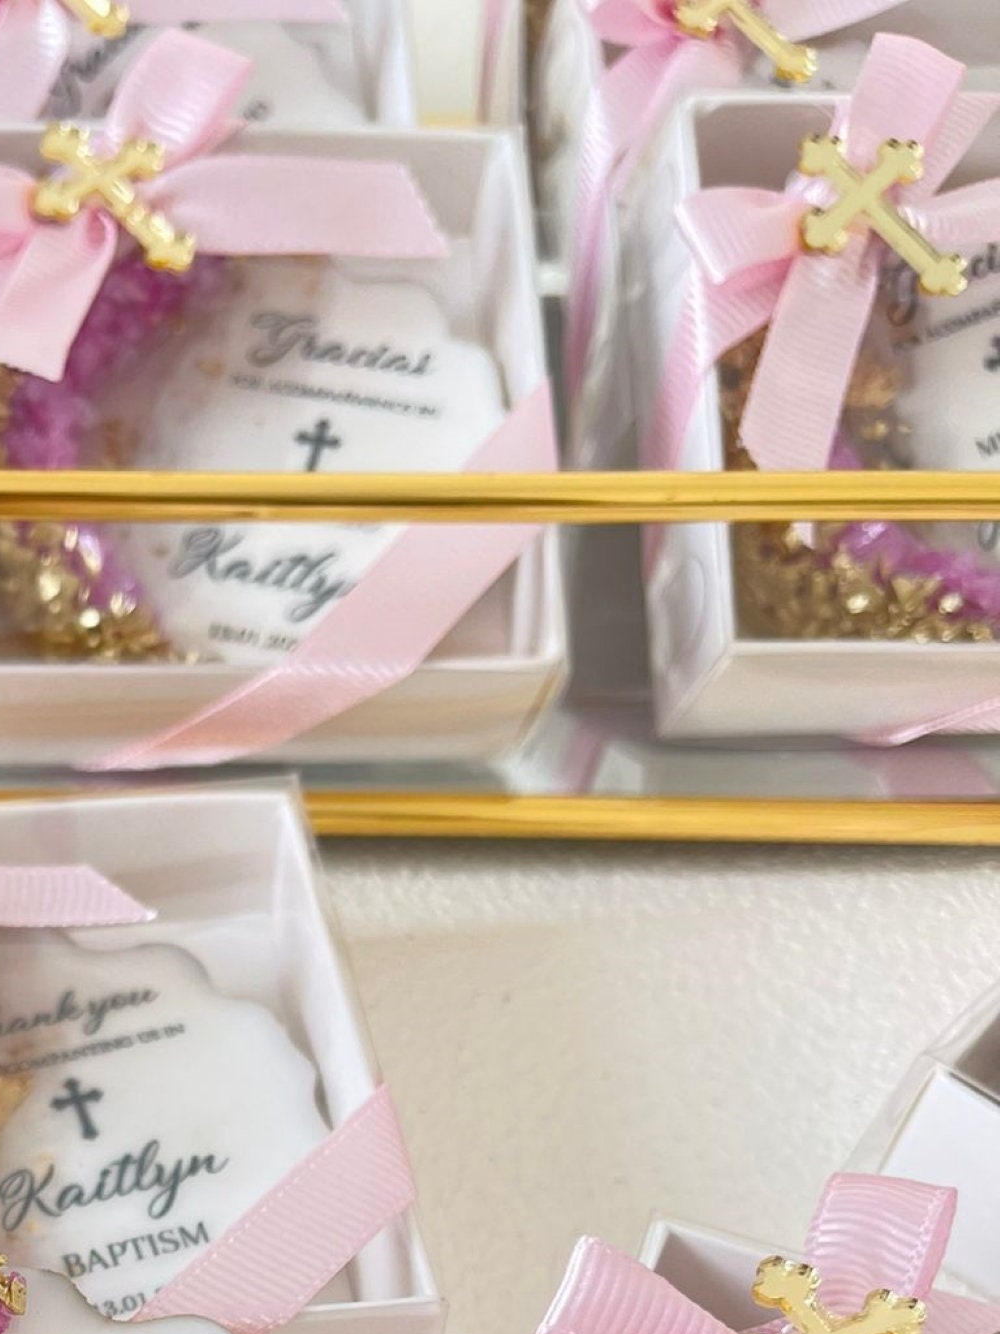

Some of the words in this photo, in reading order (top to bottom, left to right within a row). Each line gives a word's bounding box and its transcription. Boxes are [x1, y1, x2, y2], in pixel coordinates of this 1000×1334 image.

[168, 527, 358, 622] Kaitly
[81, 988, 160, 1037] you
[62, 1221, 211, 1278] BAPTISM
